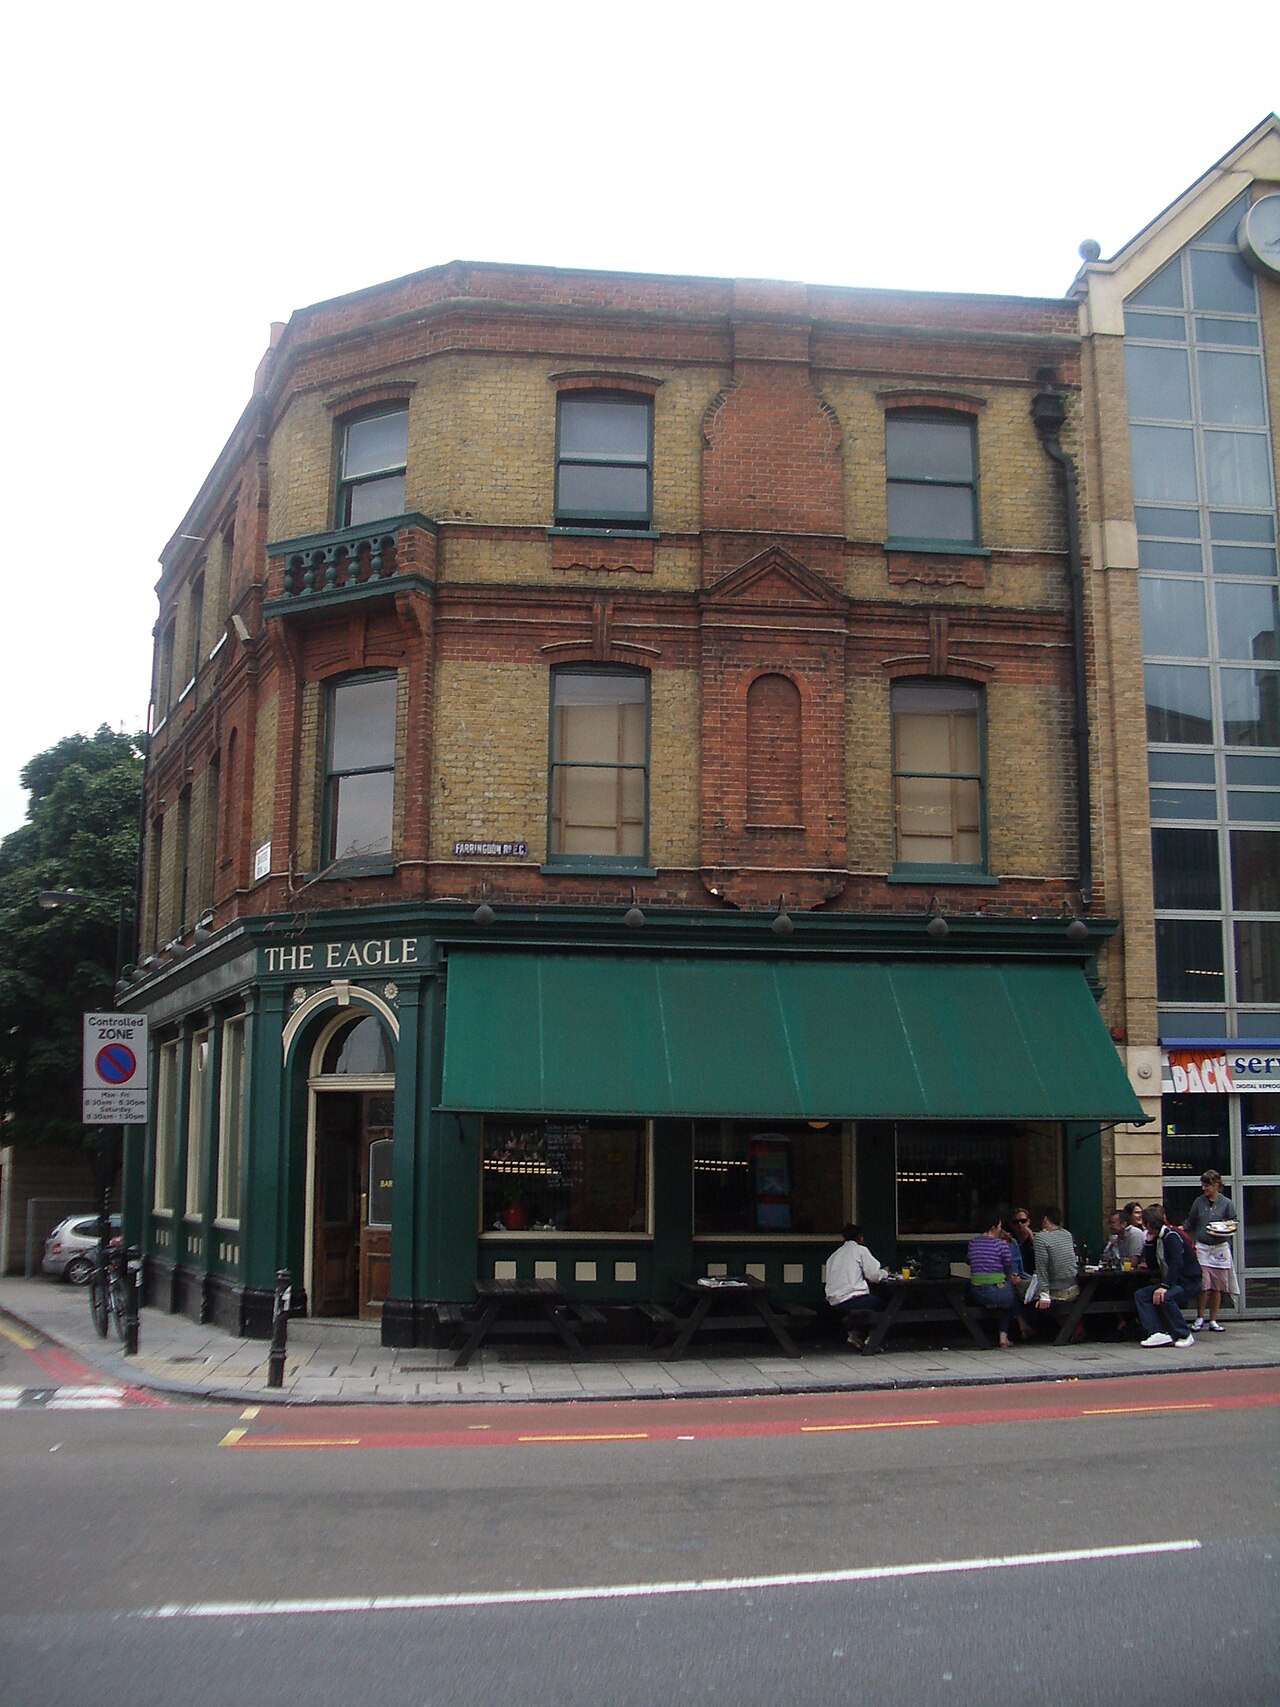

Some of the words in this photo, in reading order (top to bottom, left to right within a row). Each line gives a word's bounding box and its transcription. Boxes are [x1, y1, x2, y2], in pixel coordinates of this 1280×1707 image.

[455, 843, 502, 855] FARRINGDON
[264, 945, 314, 971] THE
[326, 938, 418, 968] EAGLE
[88, 1016, 144, 1027] Controlled
[98, 1028, 134, 1040] ZONE
[1235, 1057, 1280, 1074] ser
[100, 1106, 132, 1114] Saturday
[380, 1180, 393, 1188] BAR
